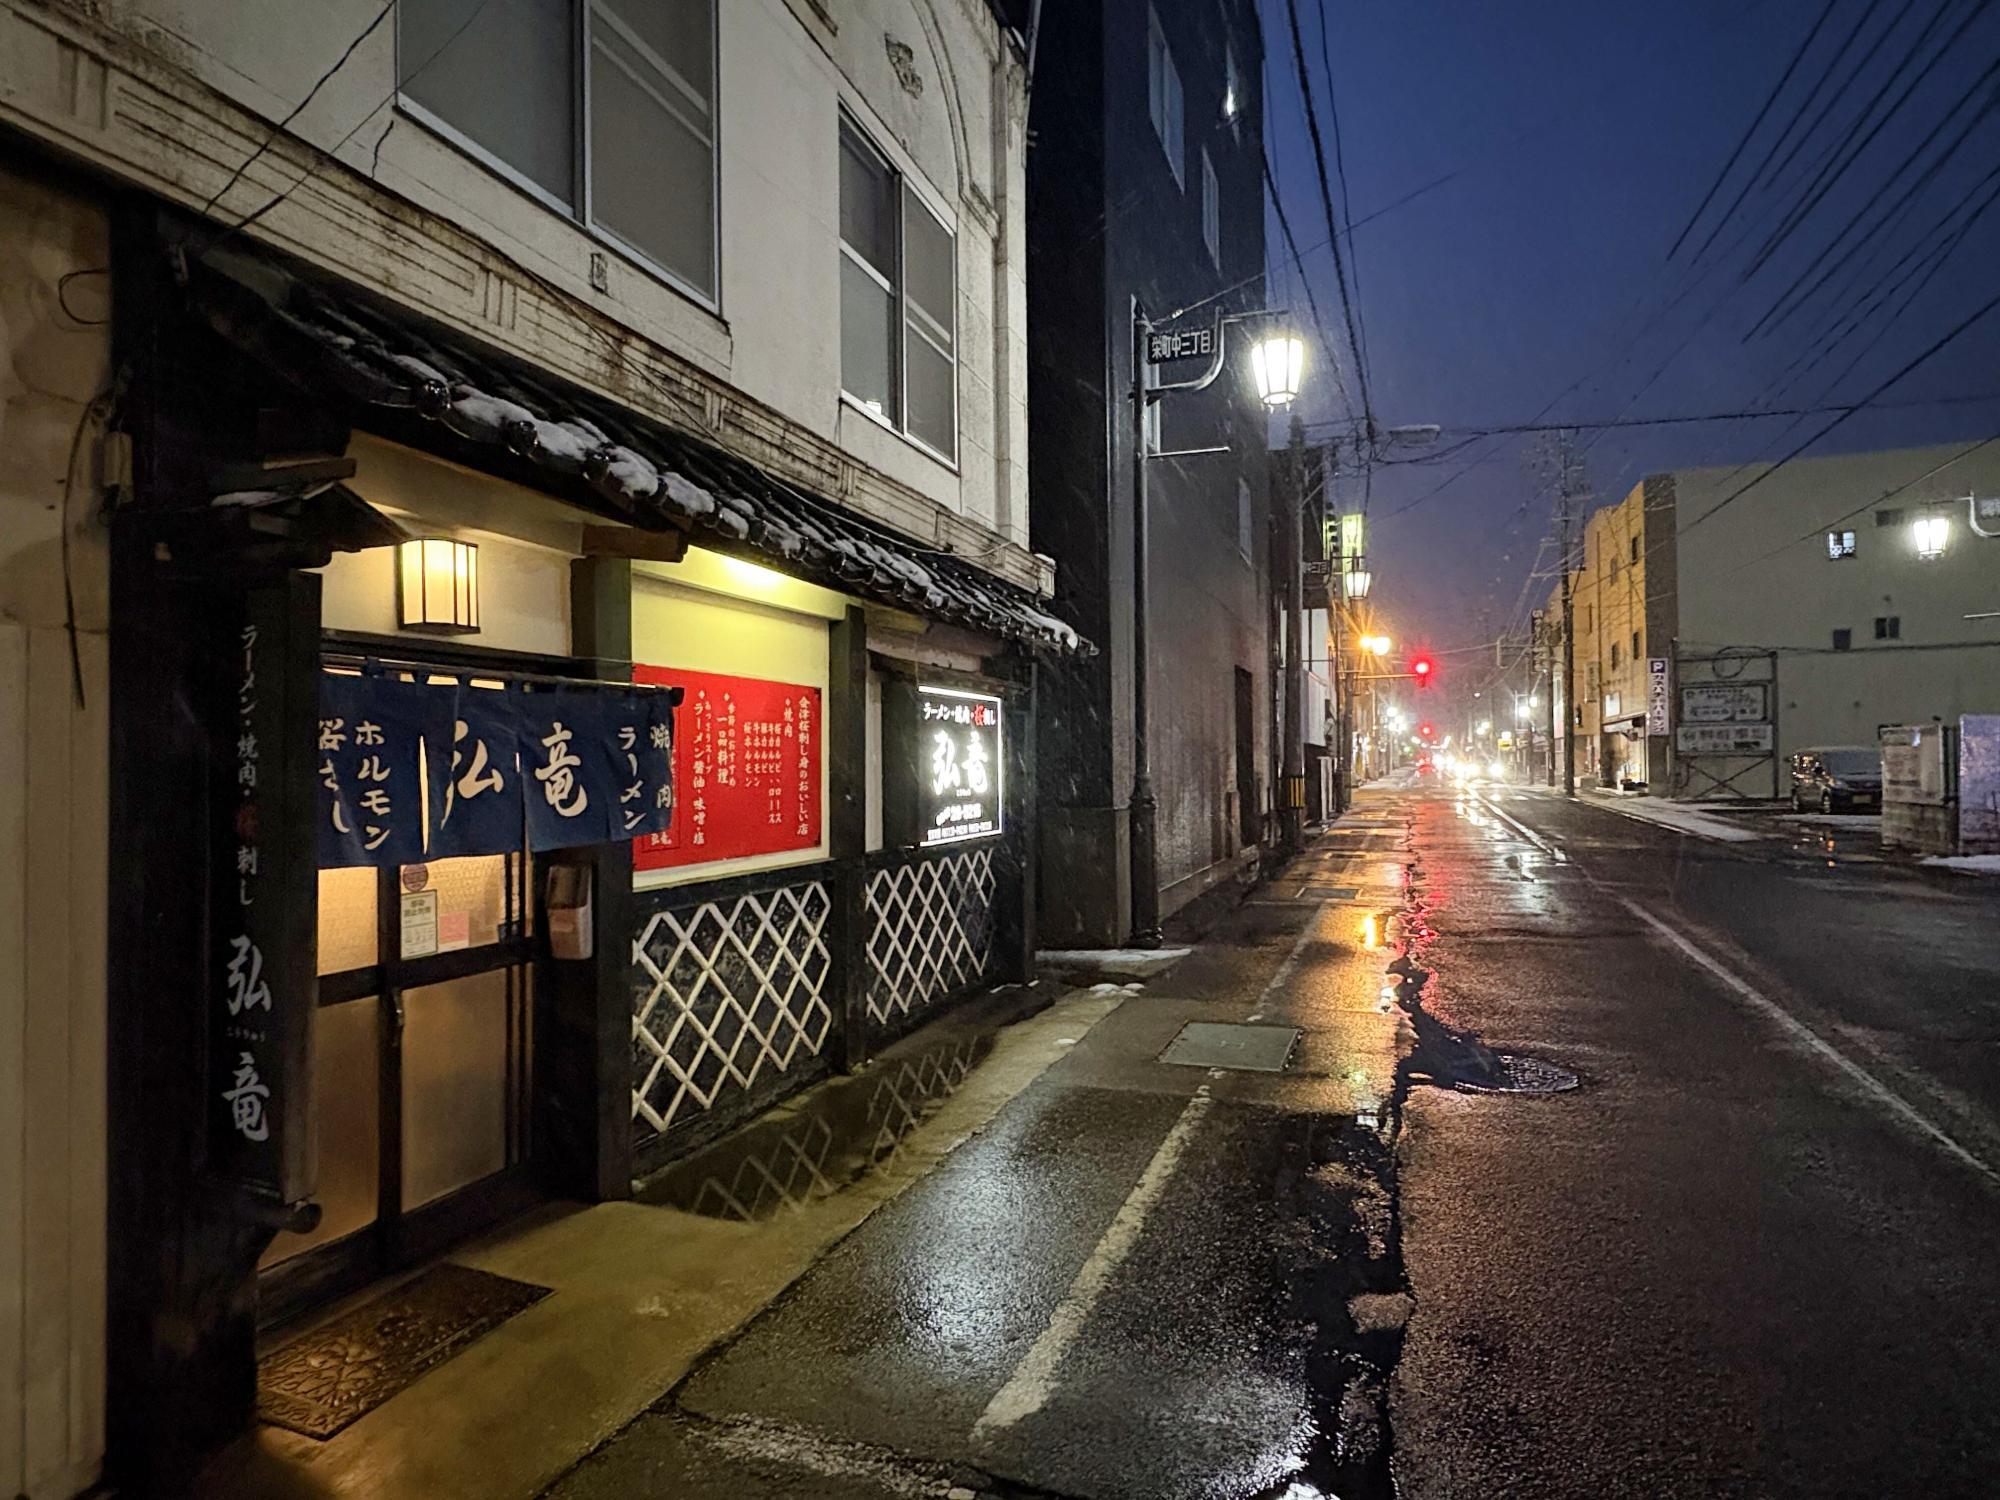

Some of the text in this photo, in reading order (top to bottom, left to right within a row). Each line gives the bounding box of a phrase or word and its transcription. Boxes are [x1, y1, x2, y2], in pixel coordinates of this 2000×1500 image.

[1151, 330, 1211, 359] 栄町中三丁目
[354, 720, 391, 851] ホルモン
[617, 726, 647, 831] ラーメン
[650, 723, 672, 809] 焼肉
[716, 716, 729, 784] 一品料理
